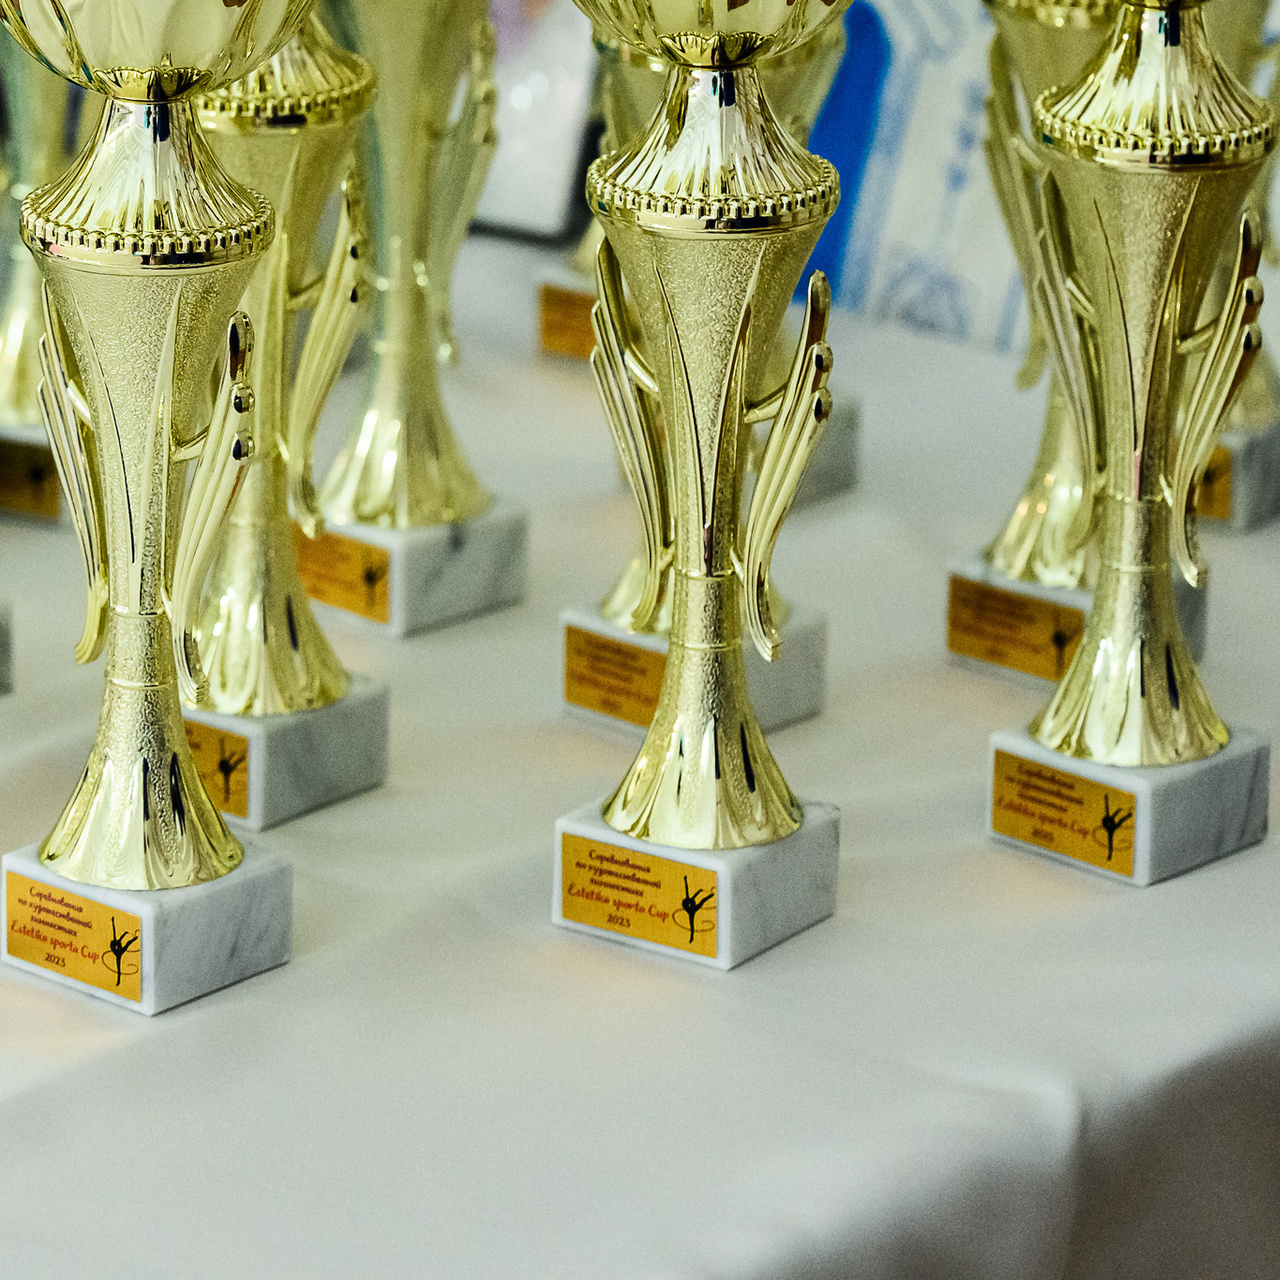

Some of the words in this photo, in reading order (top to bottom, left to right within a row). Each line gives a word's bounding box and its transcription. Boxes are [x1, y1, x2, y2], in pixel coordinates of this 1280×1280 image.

[648, 904, 670, 924] Cup
[11, 920, 48, 942] Estetika
[50, 937, 78, 954] sporta
[81, 945, 100, 964] Cup
[45, 953, 66, 968] 2023
